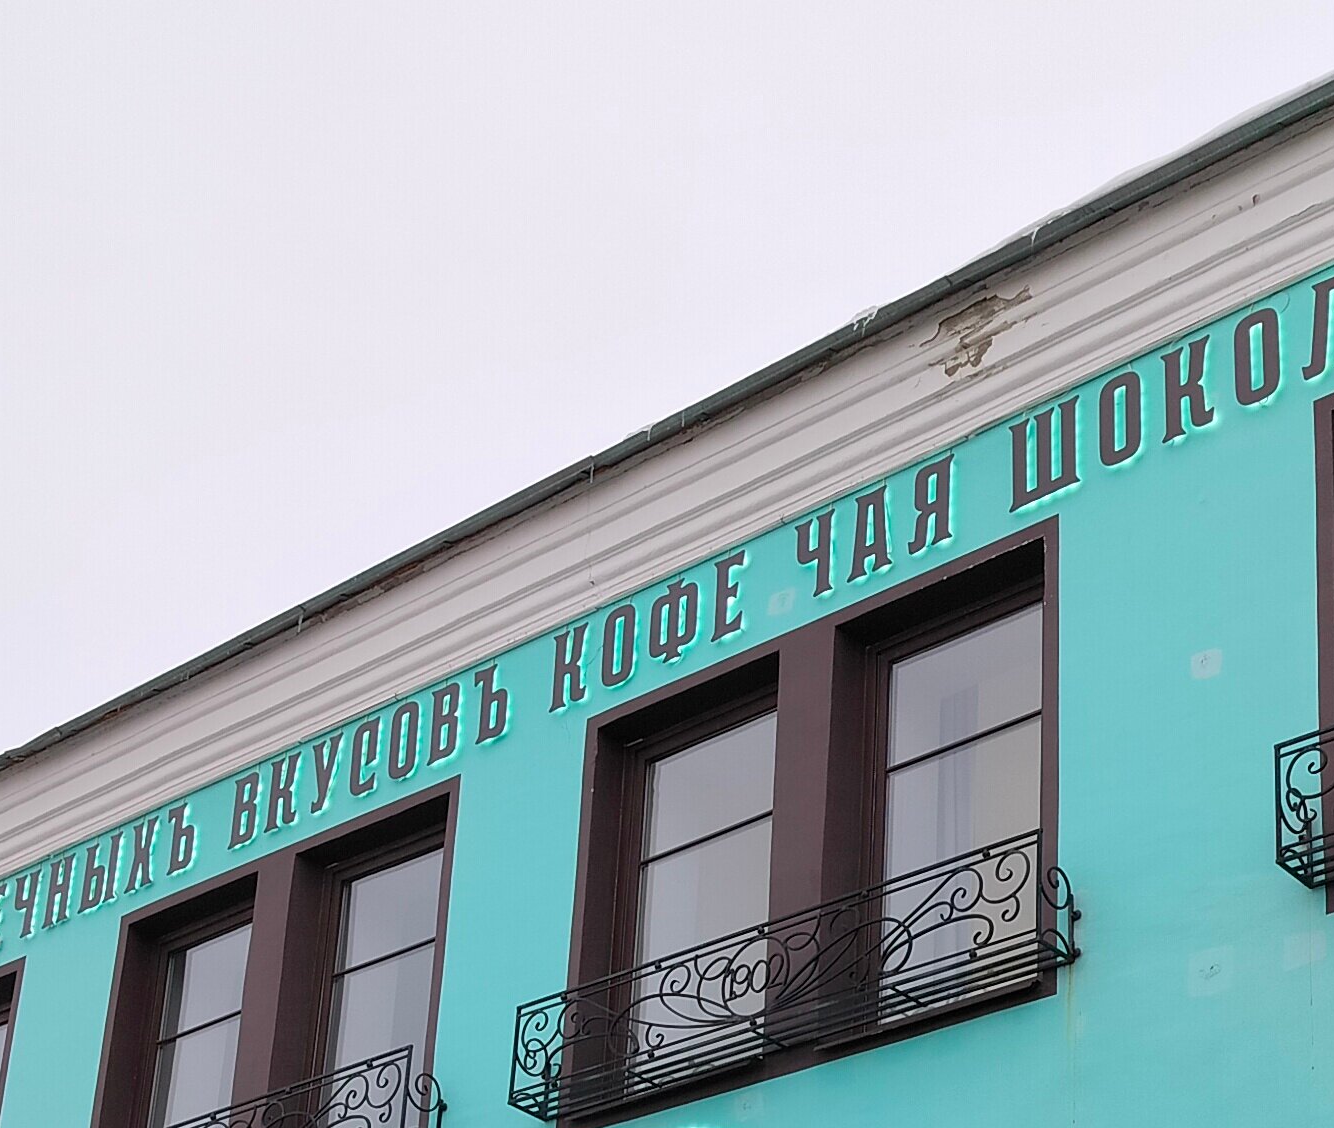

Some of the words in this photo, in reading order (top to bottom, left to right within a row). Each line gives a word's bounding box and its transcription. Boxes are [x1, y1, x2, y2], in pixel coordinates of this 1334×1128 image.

[227, 664, 509, 850] ВКУСОВЪ
[548, 550, 746, 712] КОФЕ
[795, 453, 955, 597] ЧАЯ
